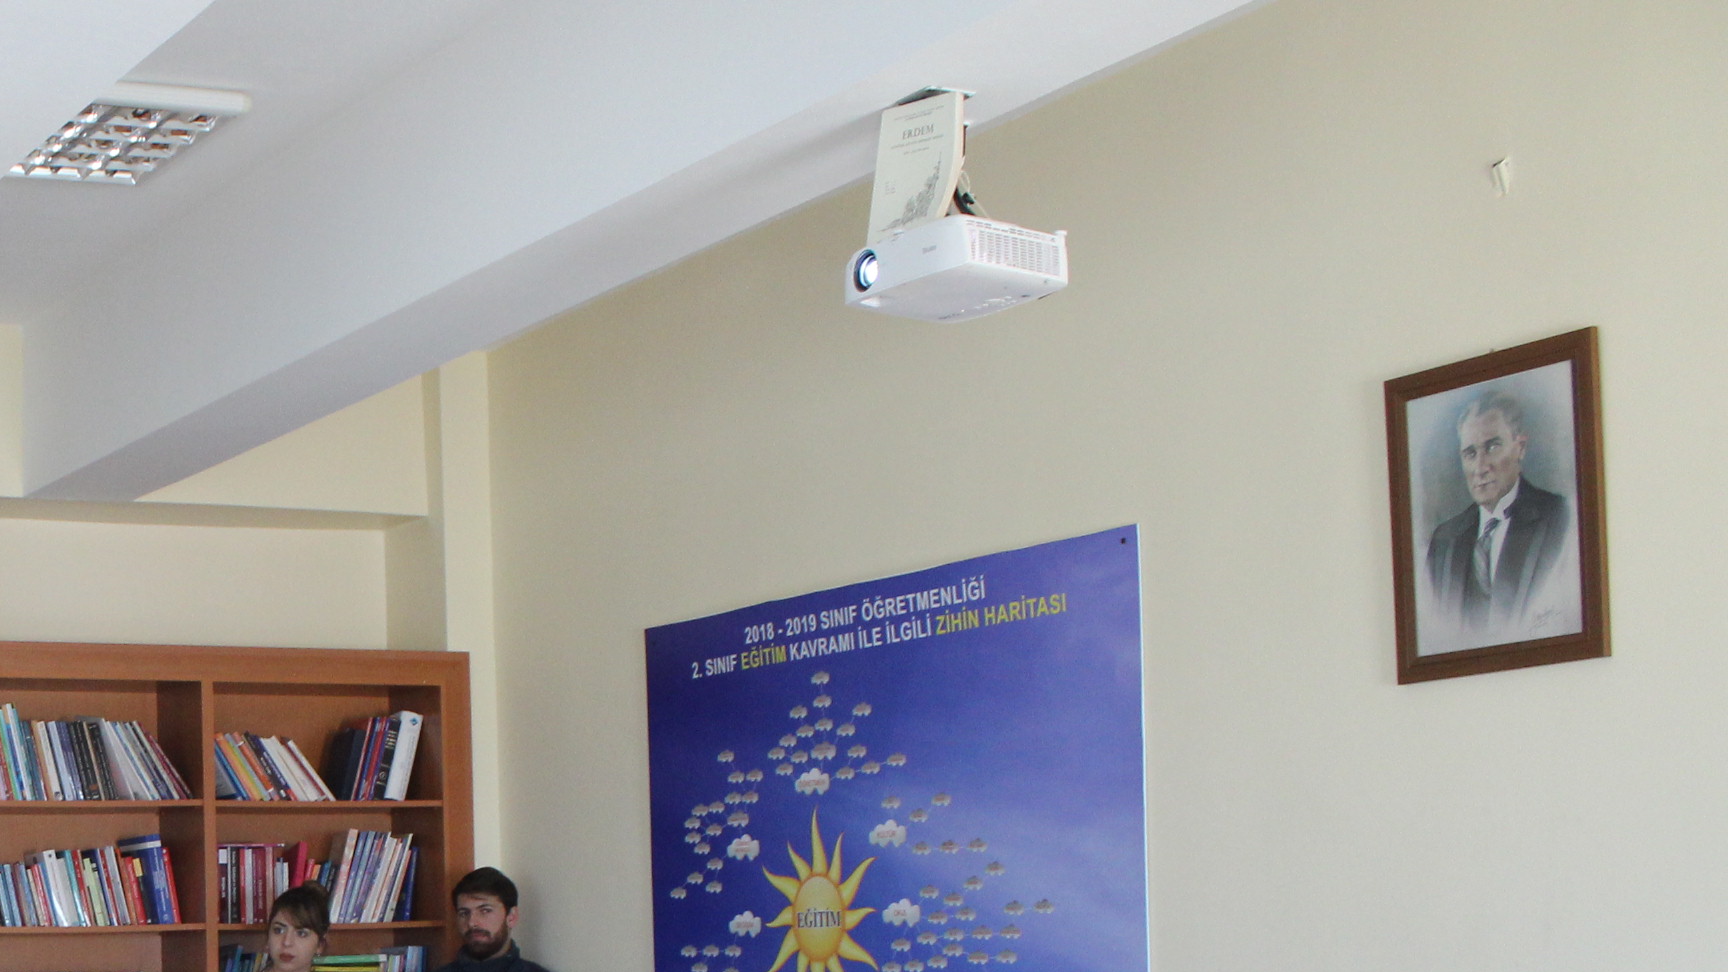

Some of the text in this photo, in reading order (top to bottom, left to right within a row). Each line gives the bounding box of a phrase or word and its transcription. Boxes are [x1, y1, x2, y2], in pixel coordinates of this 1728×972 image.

[901, 124, 934, 140] ERDEM
[744, 622, 774, 644] 2018
[786, 613, 817, 636] 2019
[820, 605, 857, 630] SINIF
[861, 575, 986, 621] ÖĞRETMENLİĞİ
[692, 593, 1067, 679] 2. SINIF EĞİTİM KAVRAMI İLE İLGİLİ ZİHİN HARİTASI
[797, 907, 841, 928] EĞİTİM
